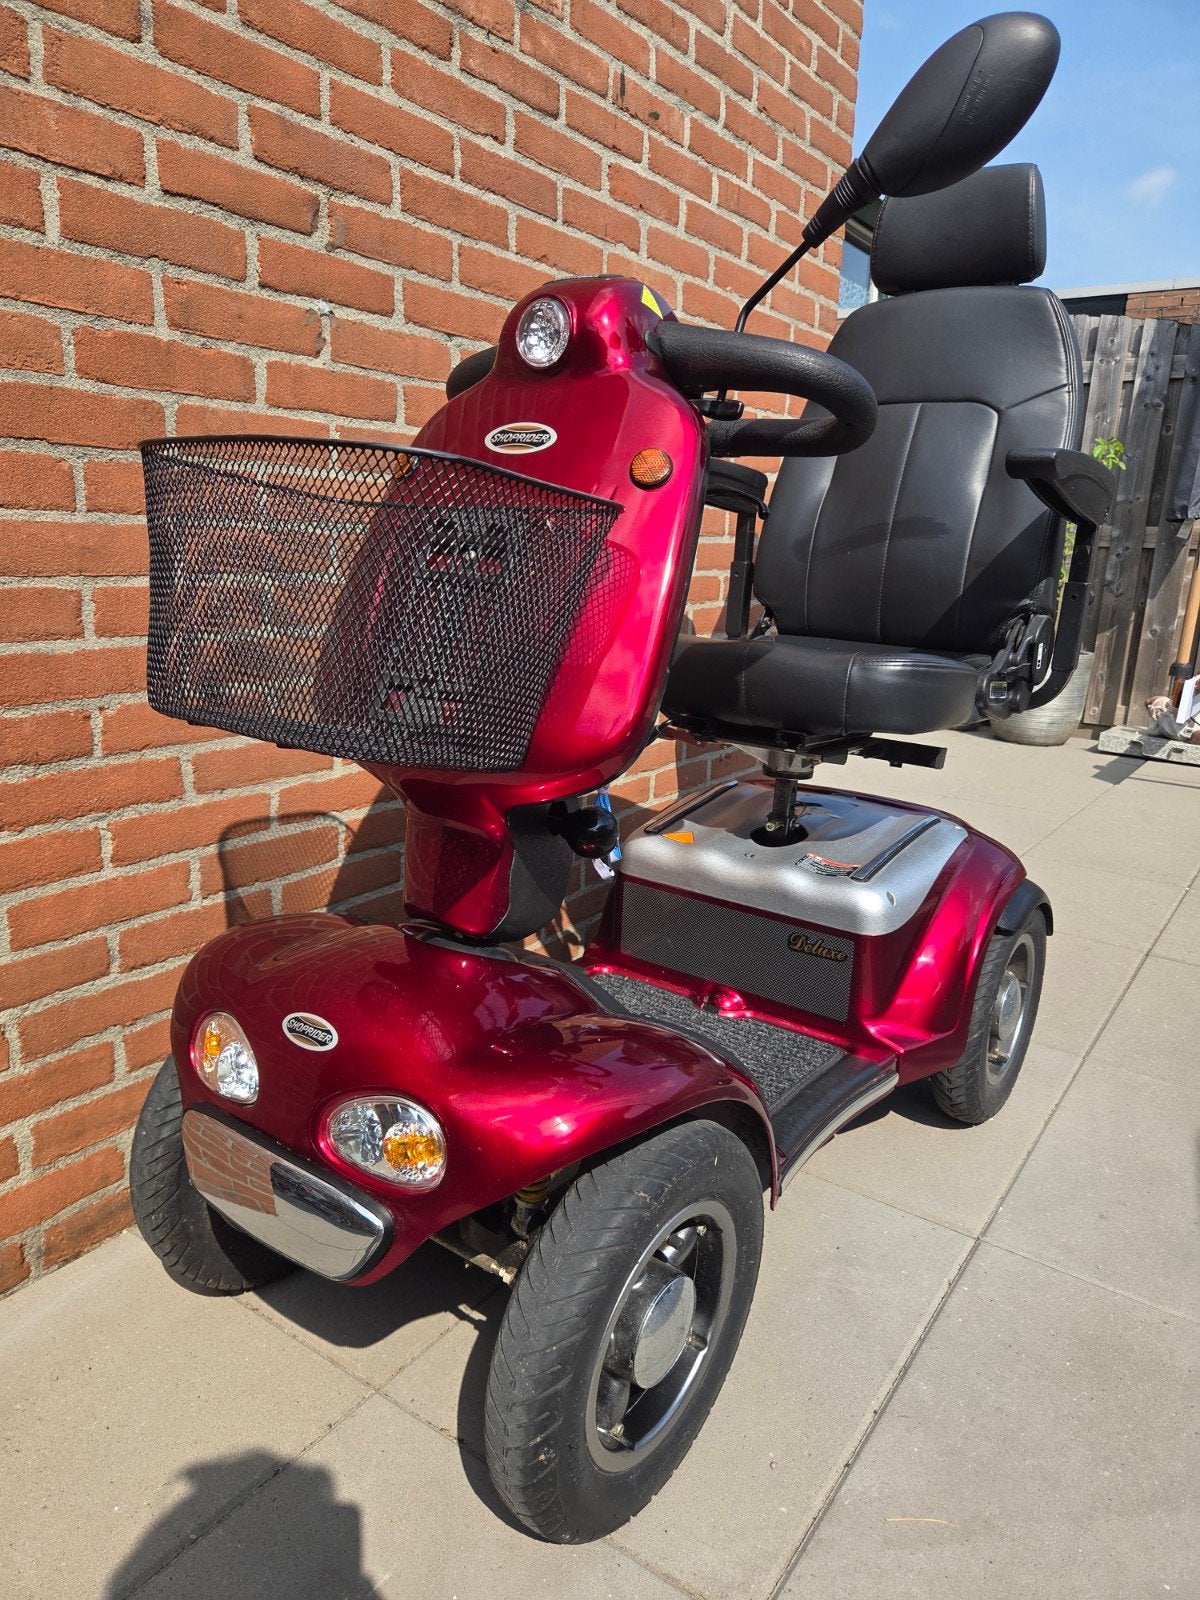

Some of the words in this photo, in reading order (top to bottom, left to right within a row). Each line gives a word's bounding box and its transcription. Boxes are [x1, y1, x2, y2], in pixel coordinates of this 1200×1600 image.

[491, 432, 551, 443] SHOPRIDER
[790, 933, 846, 960] Deluxe
[287, 1019, 332, 1044] SHOPRIDER
